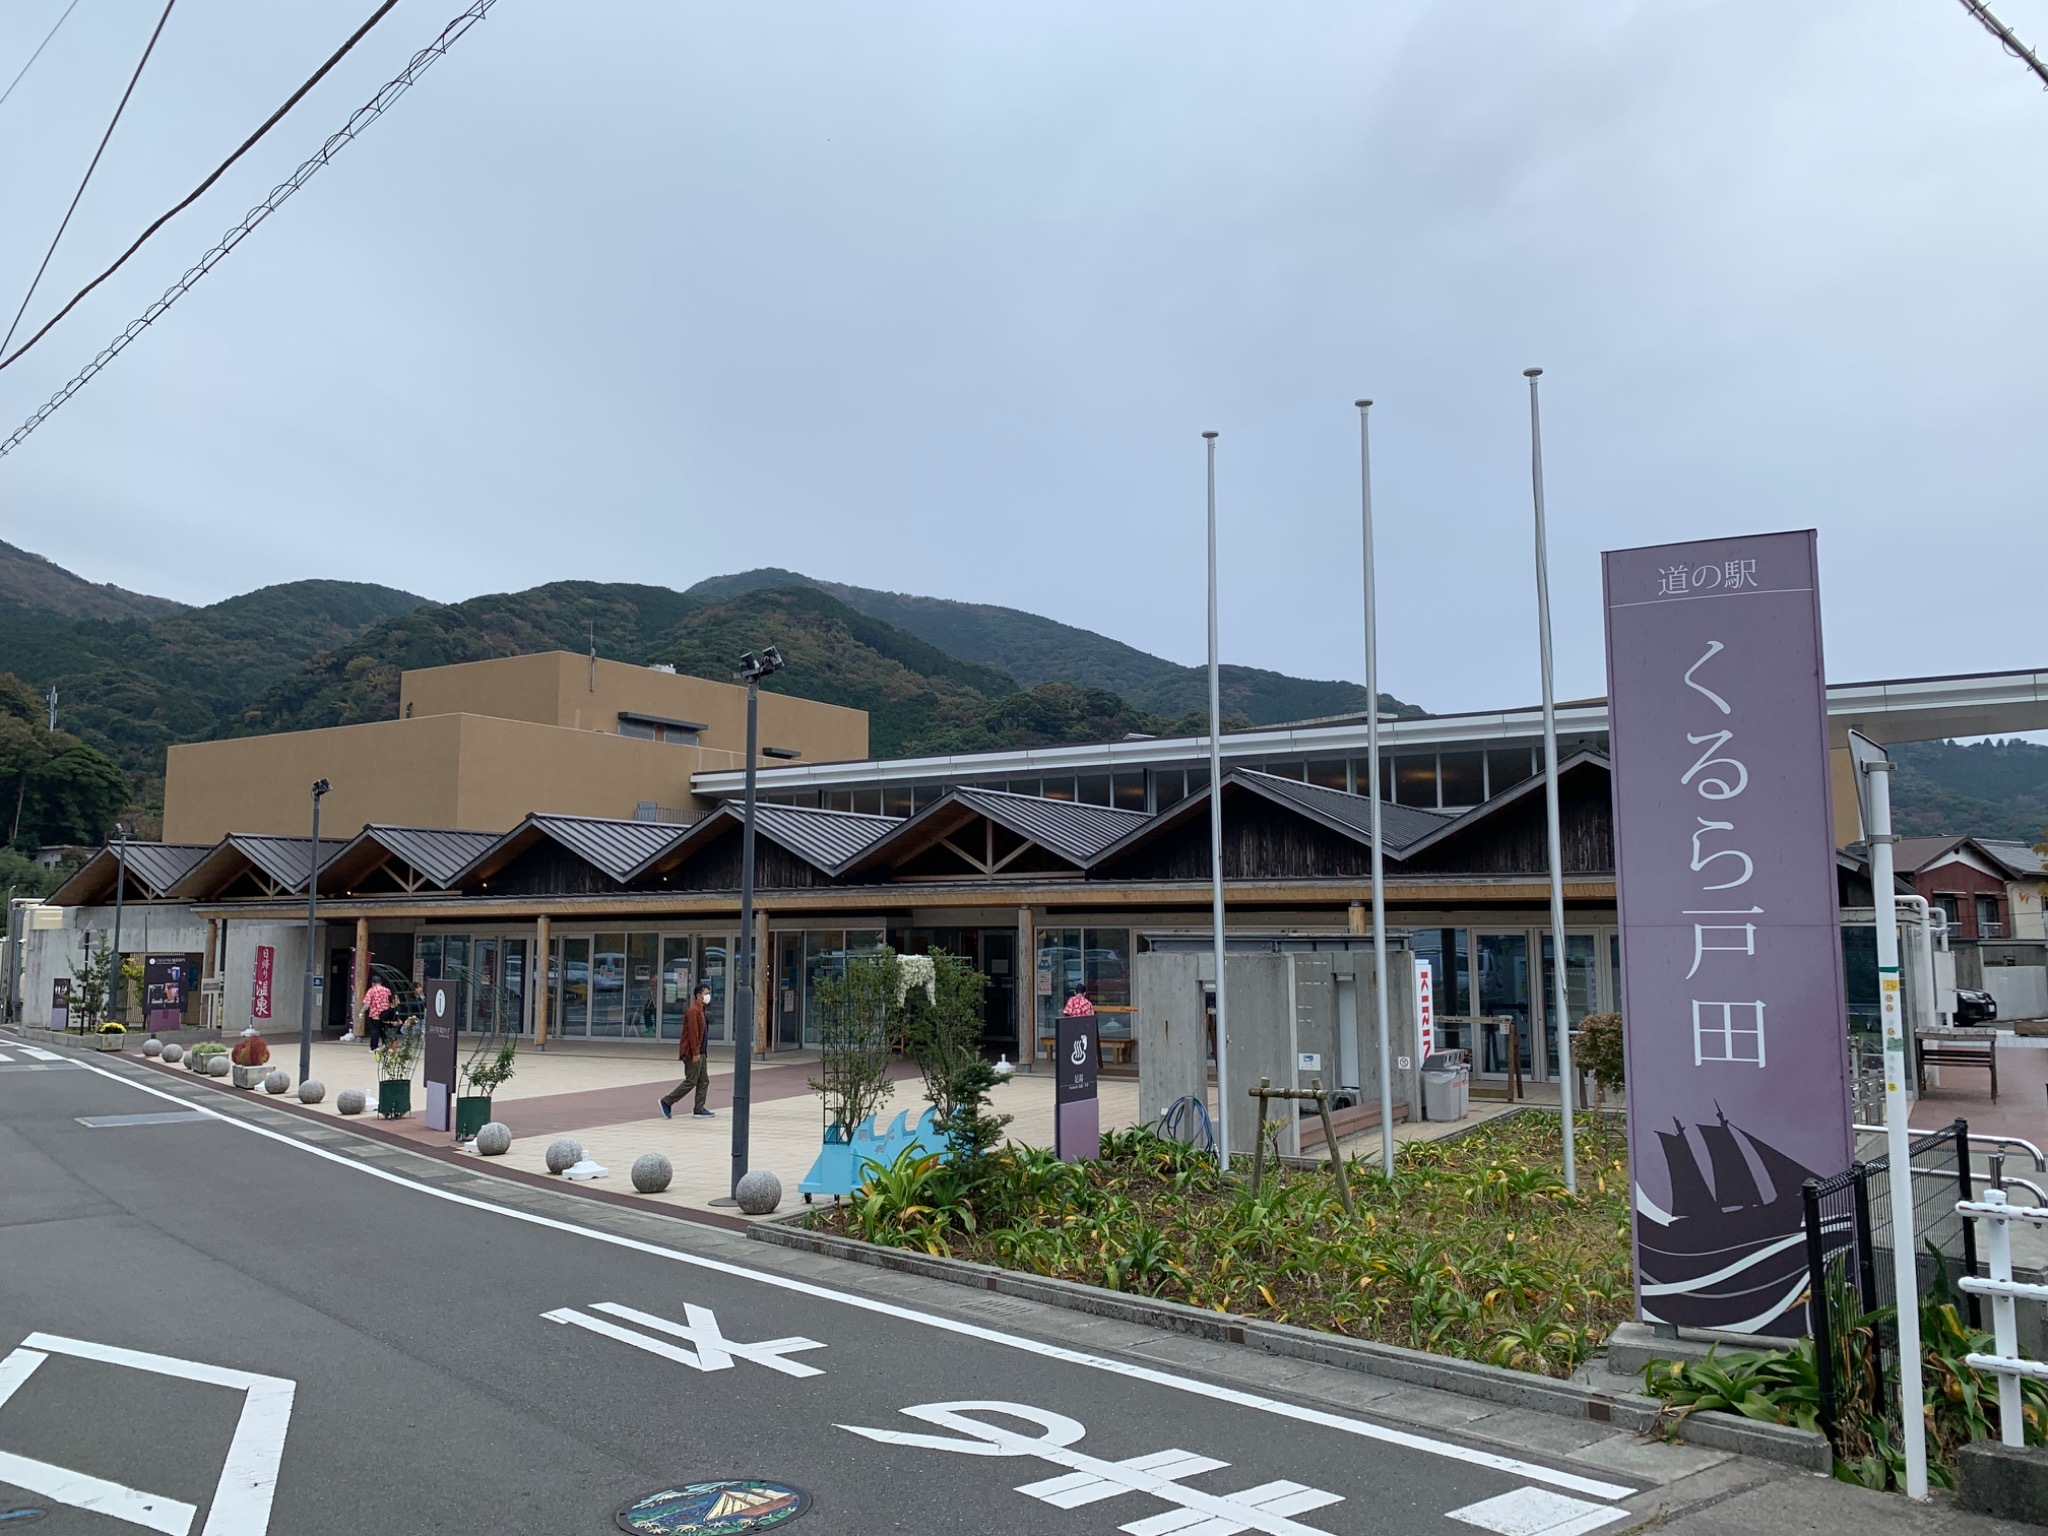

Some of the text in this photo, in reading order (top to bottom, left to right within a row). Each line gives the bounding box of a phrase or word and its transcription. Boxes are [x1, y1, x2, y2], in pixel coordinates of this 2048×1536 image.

[1657, 558, 1758, 596] 道の駅
[1681, 640, 1767, 1068] くるら戸田
[256, 948, 270, 1016] 日帰り温泉
[1420, 971, 1432, 1062] KIRIN
